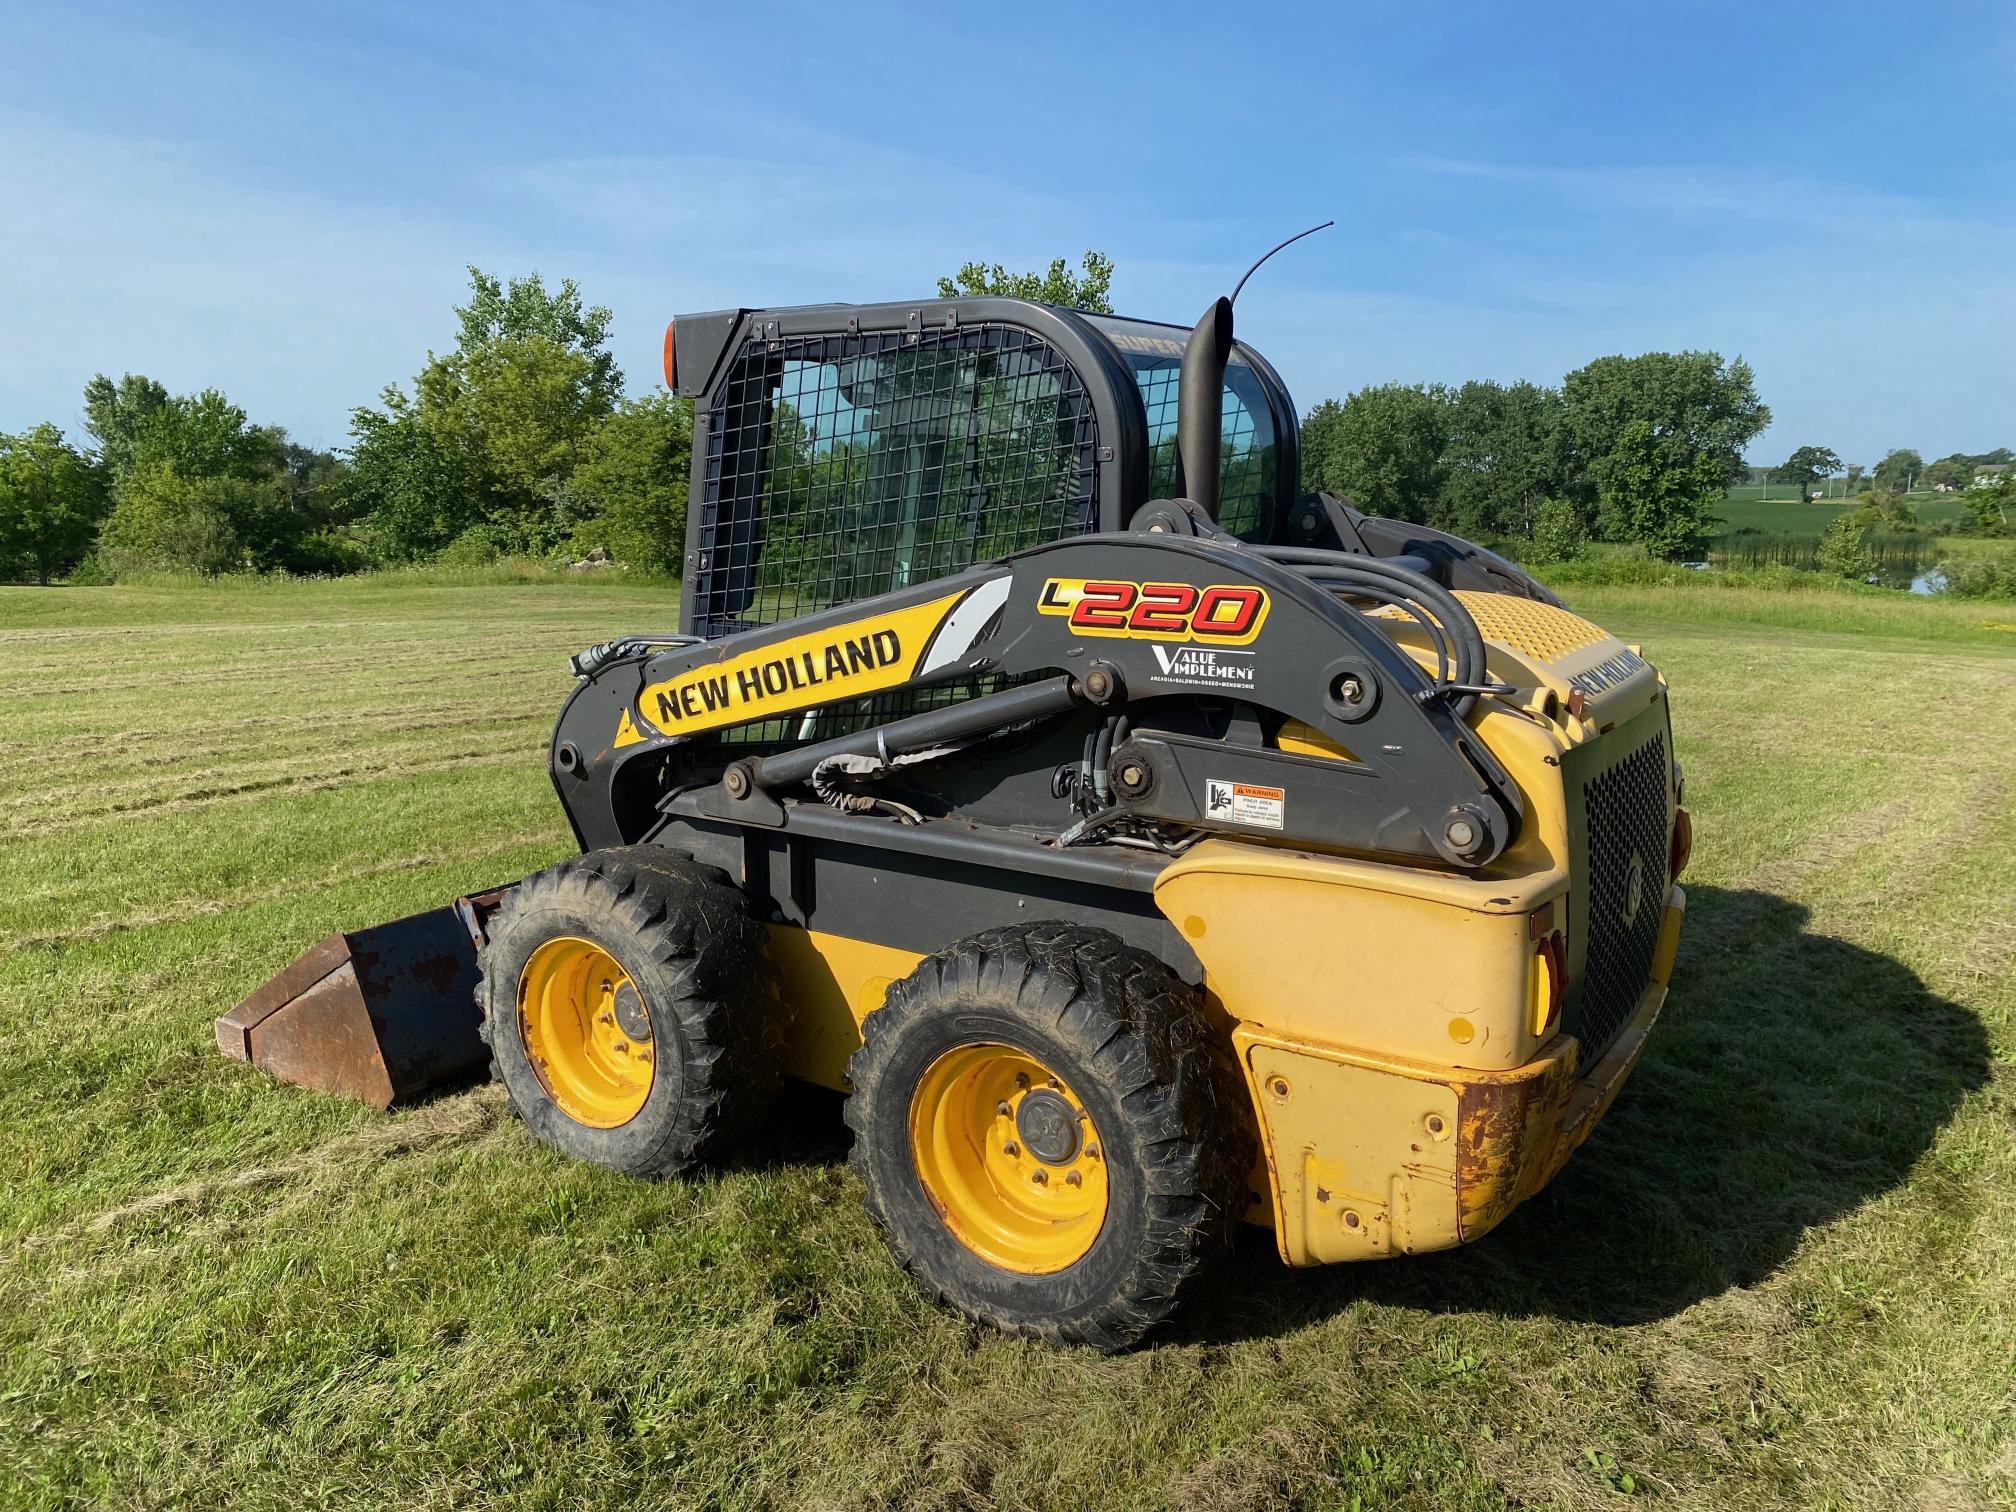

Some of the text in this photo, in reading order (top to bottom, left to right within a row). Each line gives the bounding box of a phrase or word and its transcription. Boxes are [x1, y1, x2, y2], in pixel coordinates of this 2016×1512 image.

[1040, 581, 1265, 638] L220
[656, 629, 901, 723] NEW HOLLAND
[1174, 663, 1255, 681] IMPLEMENT
[1568, 669, 1610, 696] NEW
[1245, 788, 1279, 798] WARNING
